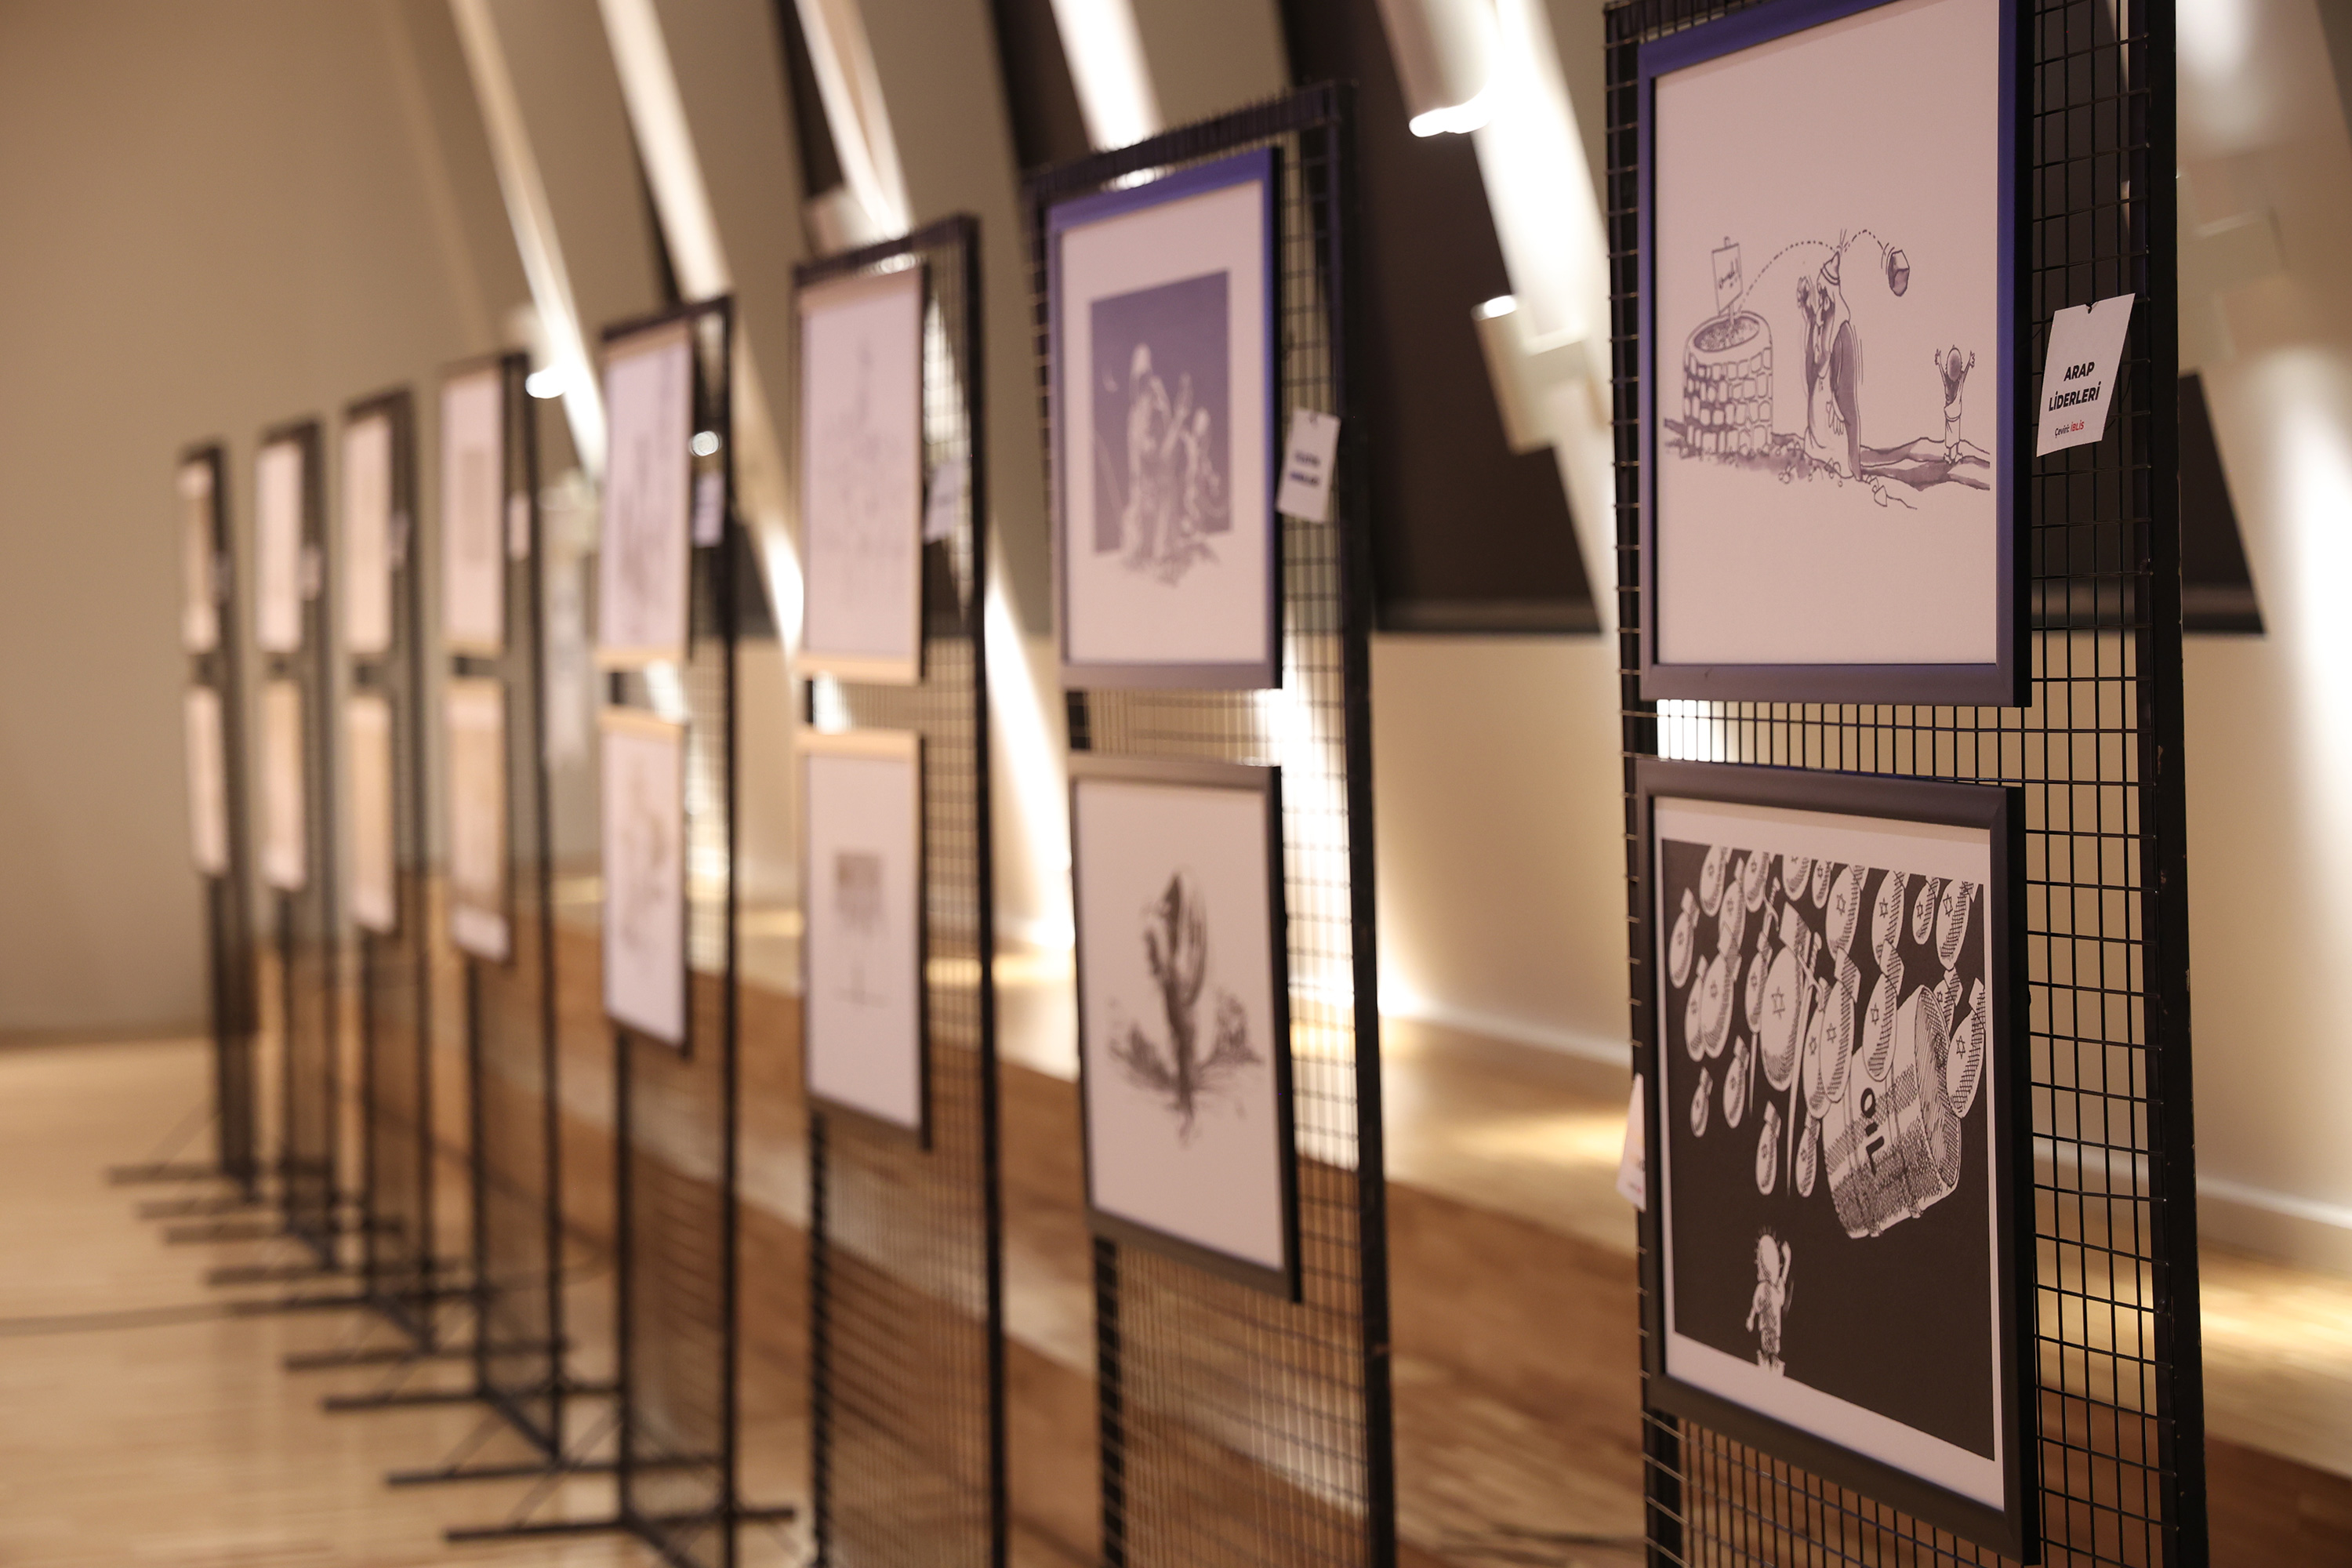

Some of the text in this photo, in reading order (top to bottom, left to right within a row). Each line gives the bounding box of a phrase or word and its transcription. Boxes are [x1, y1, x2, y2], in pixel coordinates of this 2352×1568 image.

[2063, 361, 2095, 381] ARAP
[2049, 381, 2101, 412] LİDERLERİ
[2070, 419, 2085, 432] İBLİS
[1860, 1087, 1885, 1177] OIL
